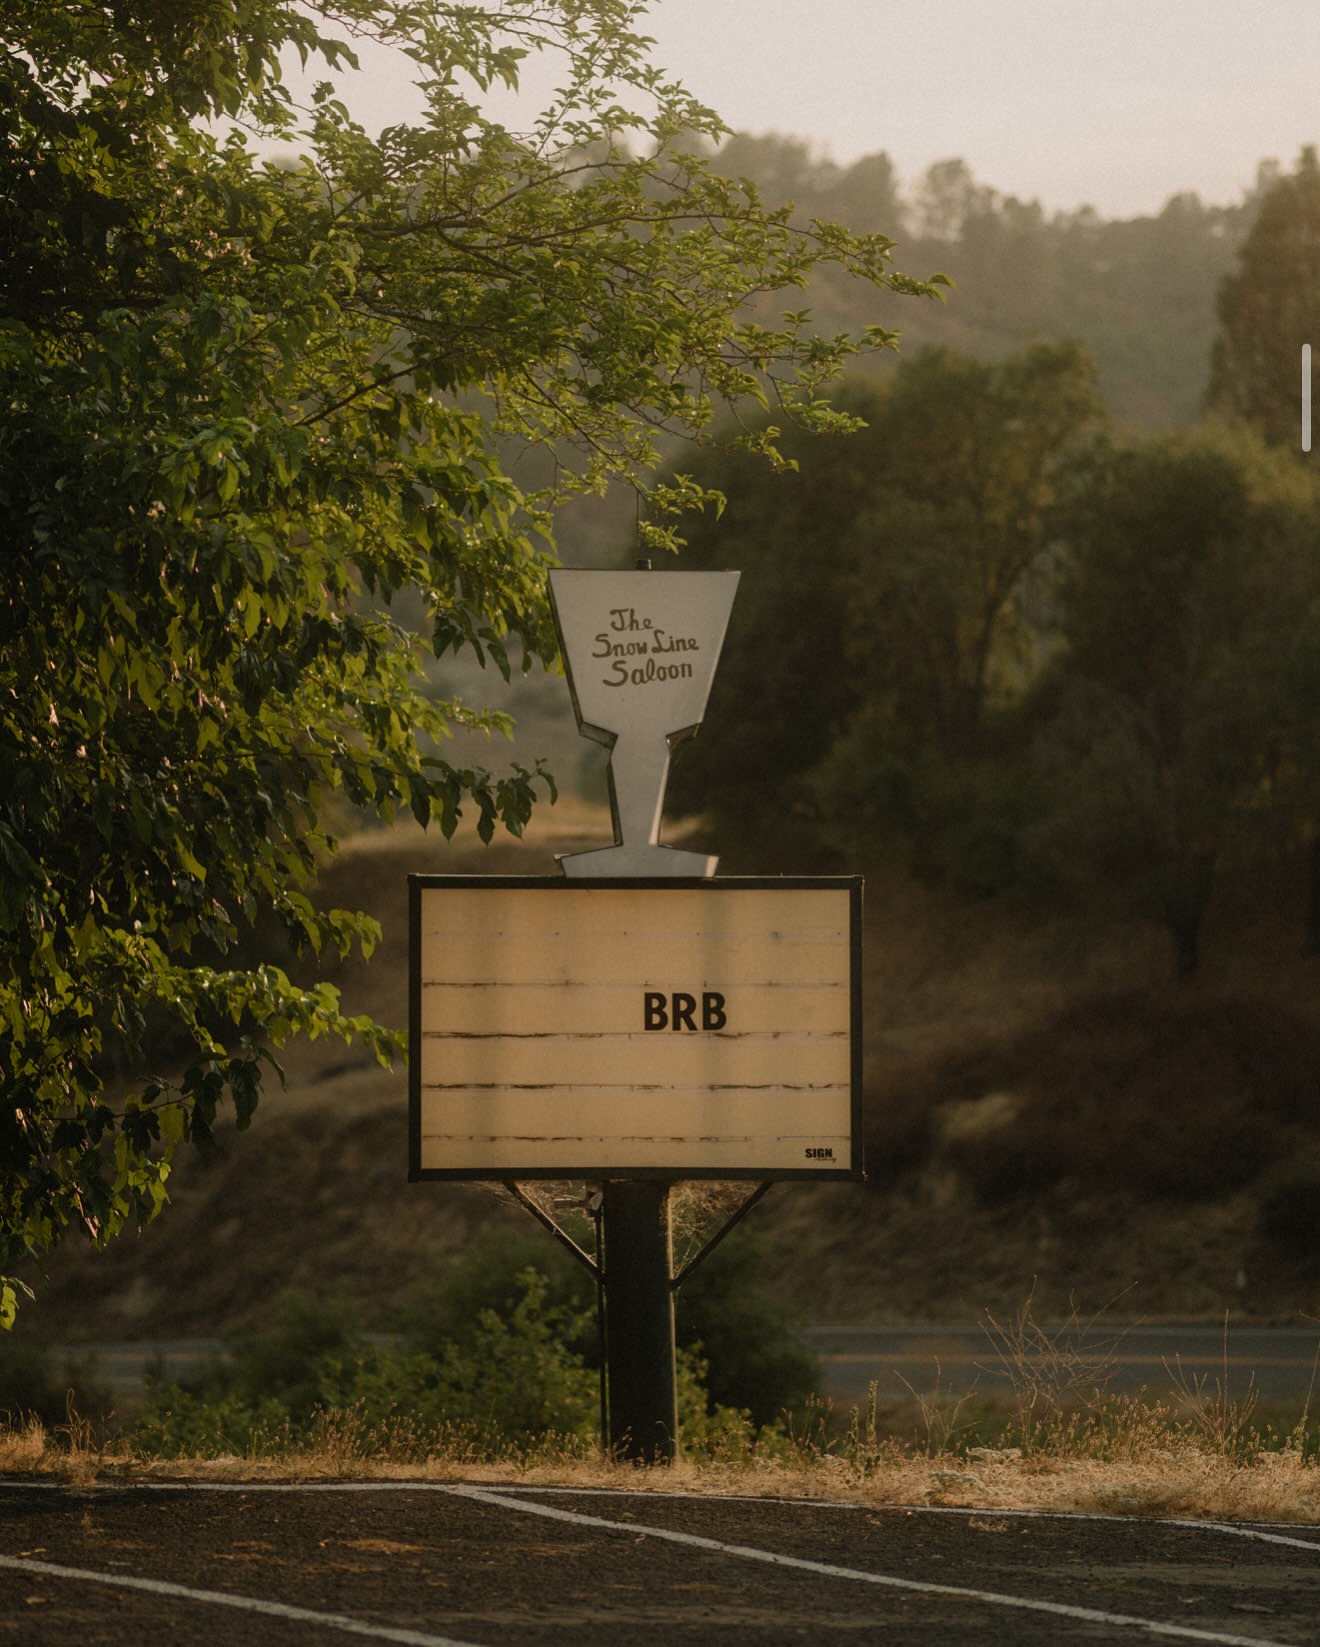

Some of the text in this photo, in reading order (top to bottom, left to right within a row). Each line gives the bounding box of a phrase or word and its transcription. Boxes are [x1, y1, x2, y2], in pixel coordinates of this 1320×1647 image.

[610, 608, 654, 631] The
[592, 629, 700, 658] Snow Line
[602, 658, 693, 687] Saloon
[644, 992, 727, 1031] BRB
[805, 1147, 833, 1159] SIGN
